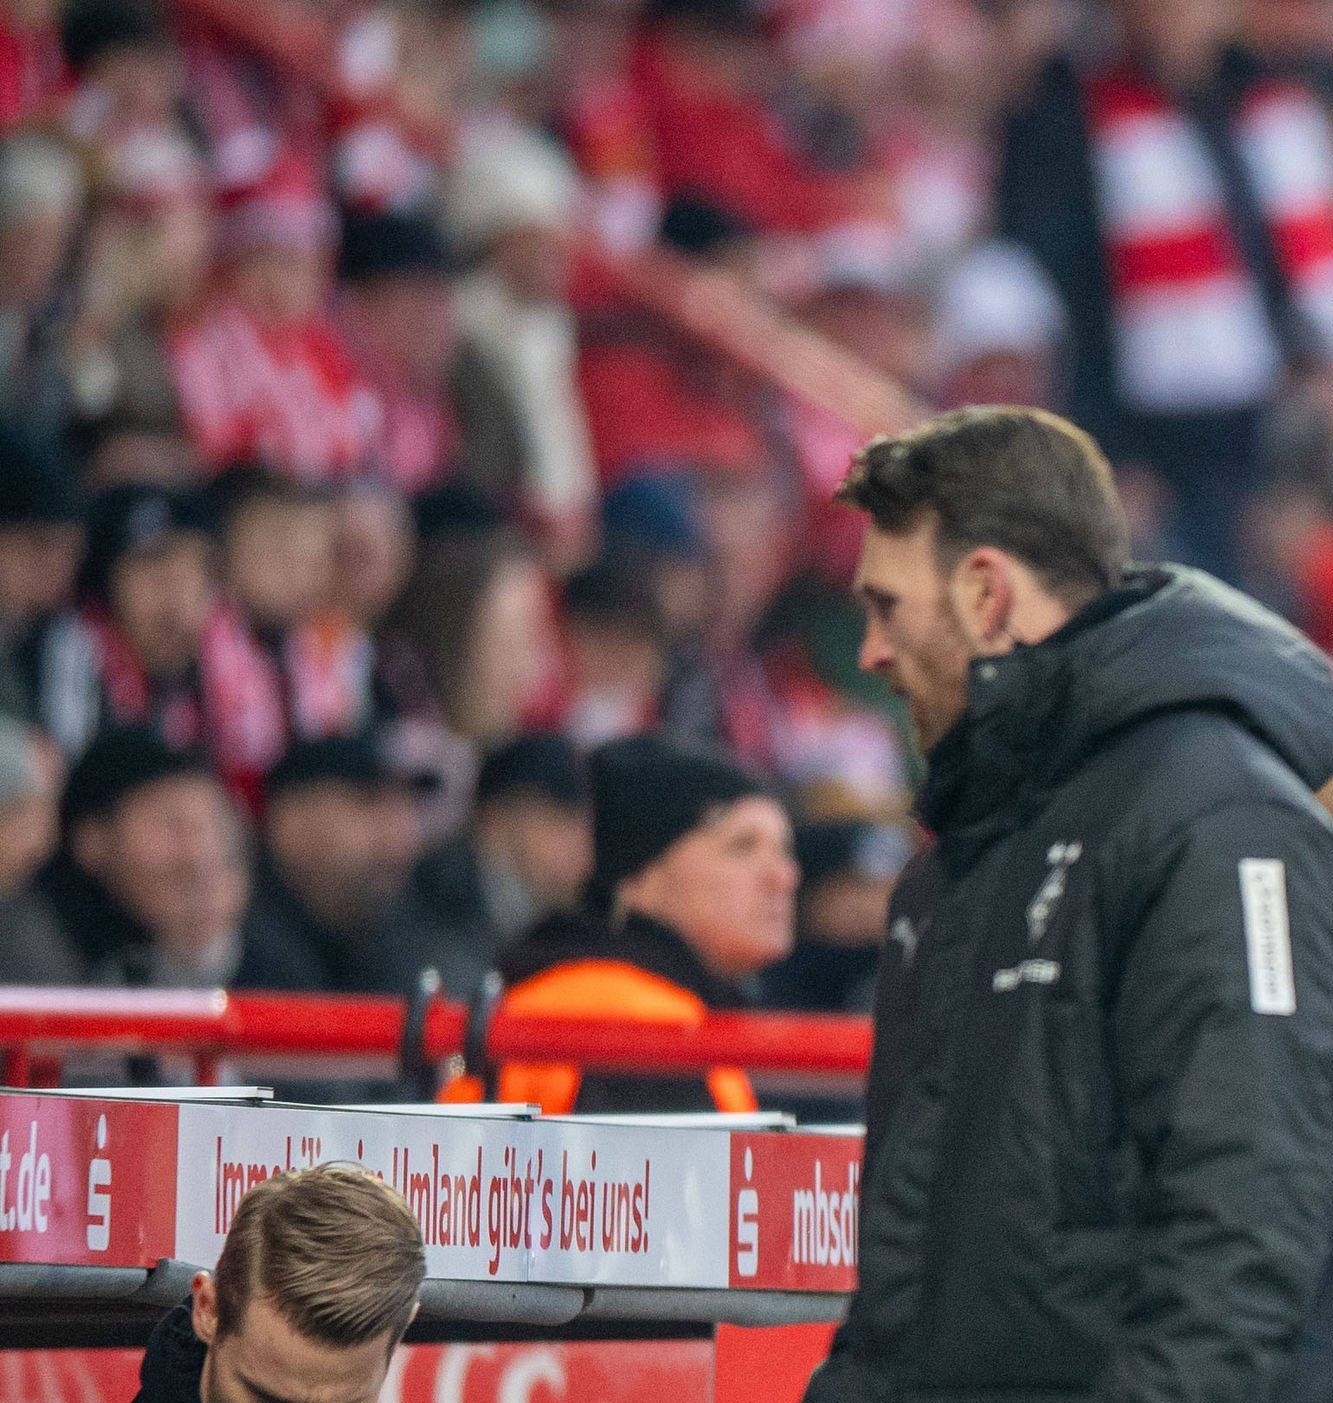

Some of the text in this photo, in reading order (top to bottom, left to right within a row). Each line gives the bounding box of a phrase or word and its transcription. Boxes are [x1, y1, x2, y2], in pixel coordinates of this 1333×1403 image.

[487, 1147, 554, 1276] gibt's
[560, 1149, 597, 1253] bei
[602, 1158, 651, 1254] uns!
